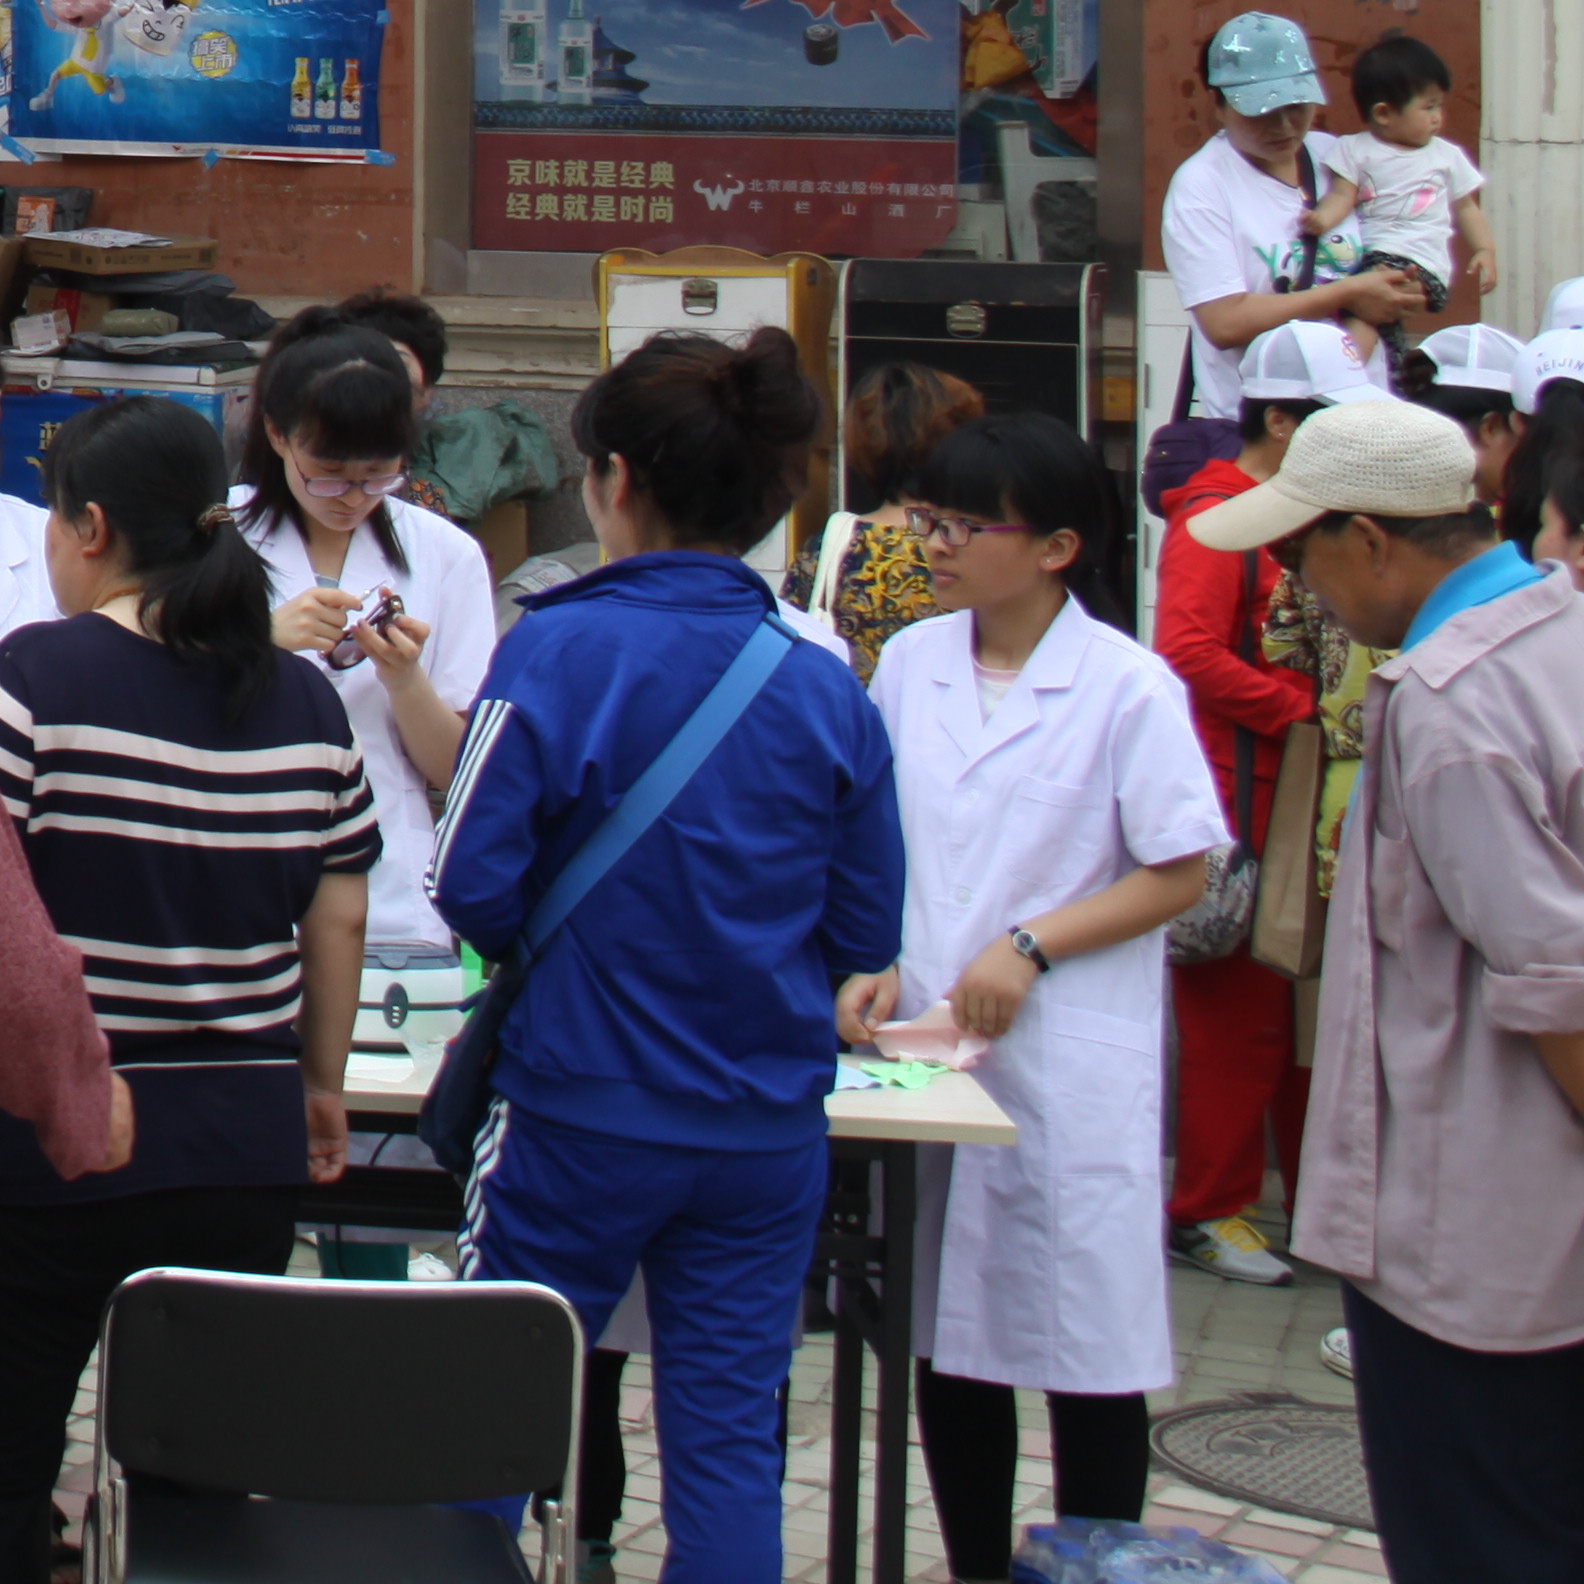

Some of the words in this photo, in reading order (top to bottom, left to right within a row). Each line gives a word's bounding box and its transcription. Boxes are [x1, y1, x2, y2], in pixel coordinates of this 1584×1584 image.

[506, 159, 676, 190] 京味就是经典
[505, 193, 675, 224] 经典就是时尚
